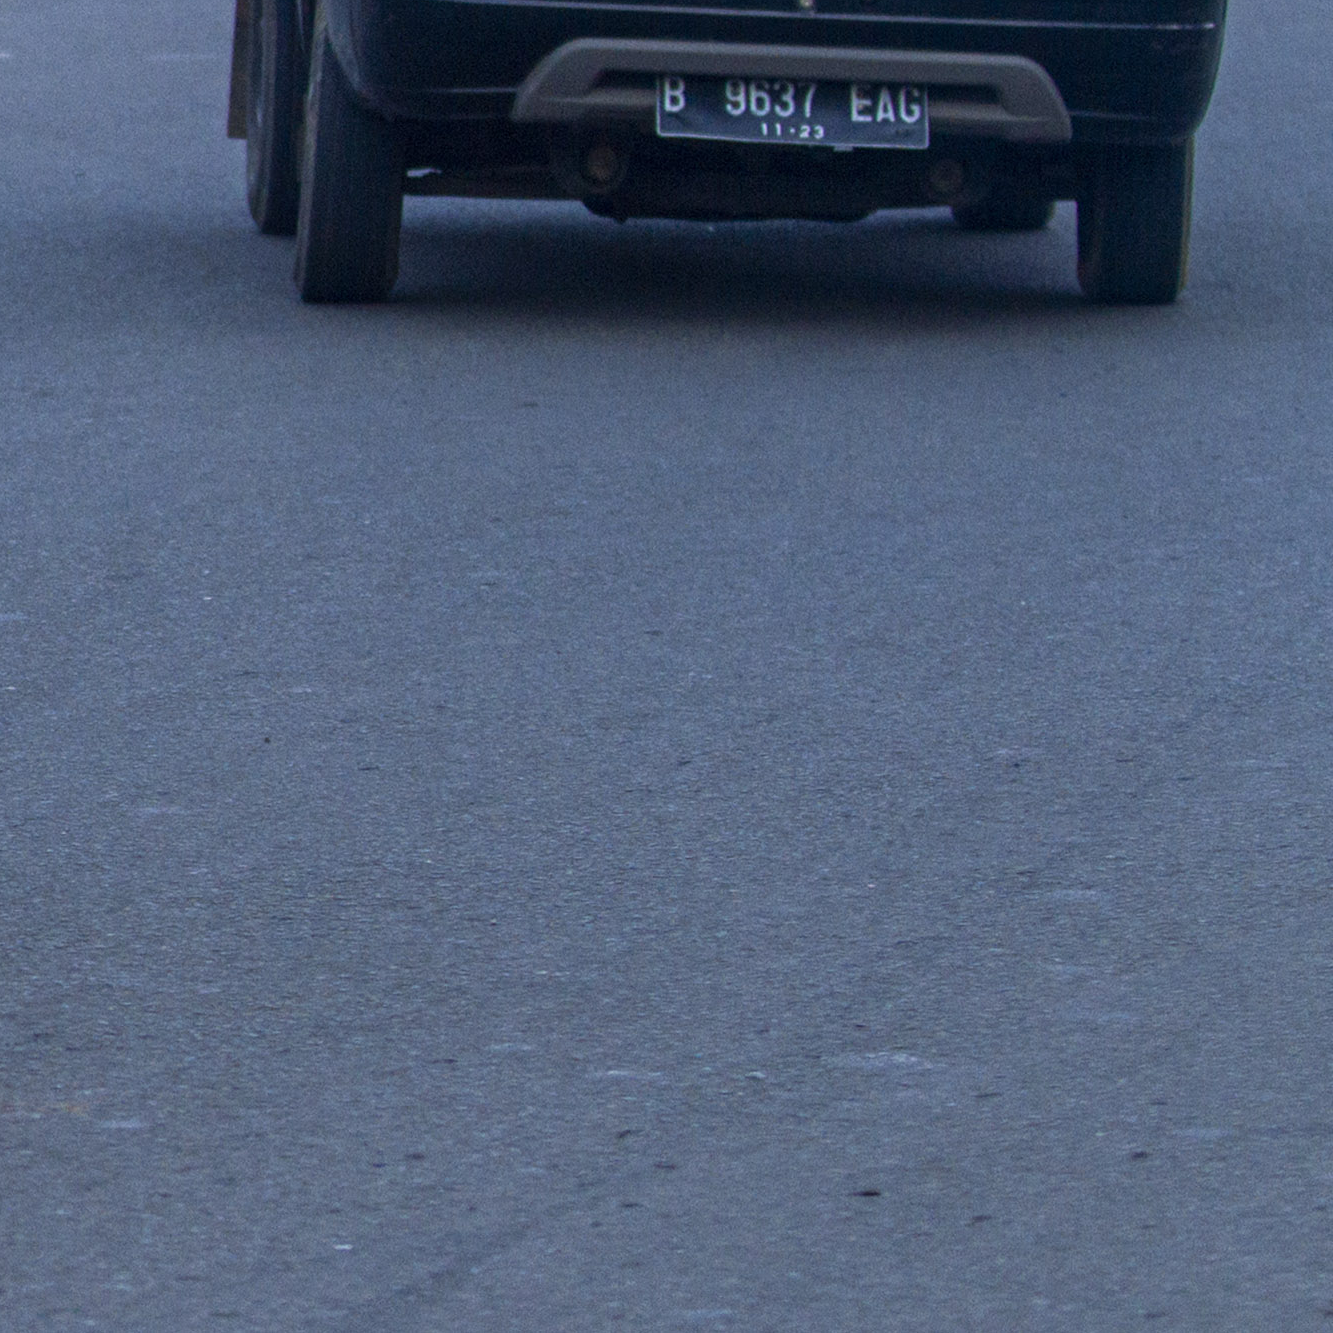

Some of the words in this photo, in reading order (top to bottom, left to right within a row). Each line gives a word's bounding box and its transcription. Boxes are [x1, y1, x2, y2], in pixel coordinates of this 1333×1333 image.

[664, 74, 685, 112] B
[725, 75, 817, 118] 9637
[850, 81, 922, 124] EAG
